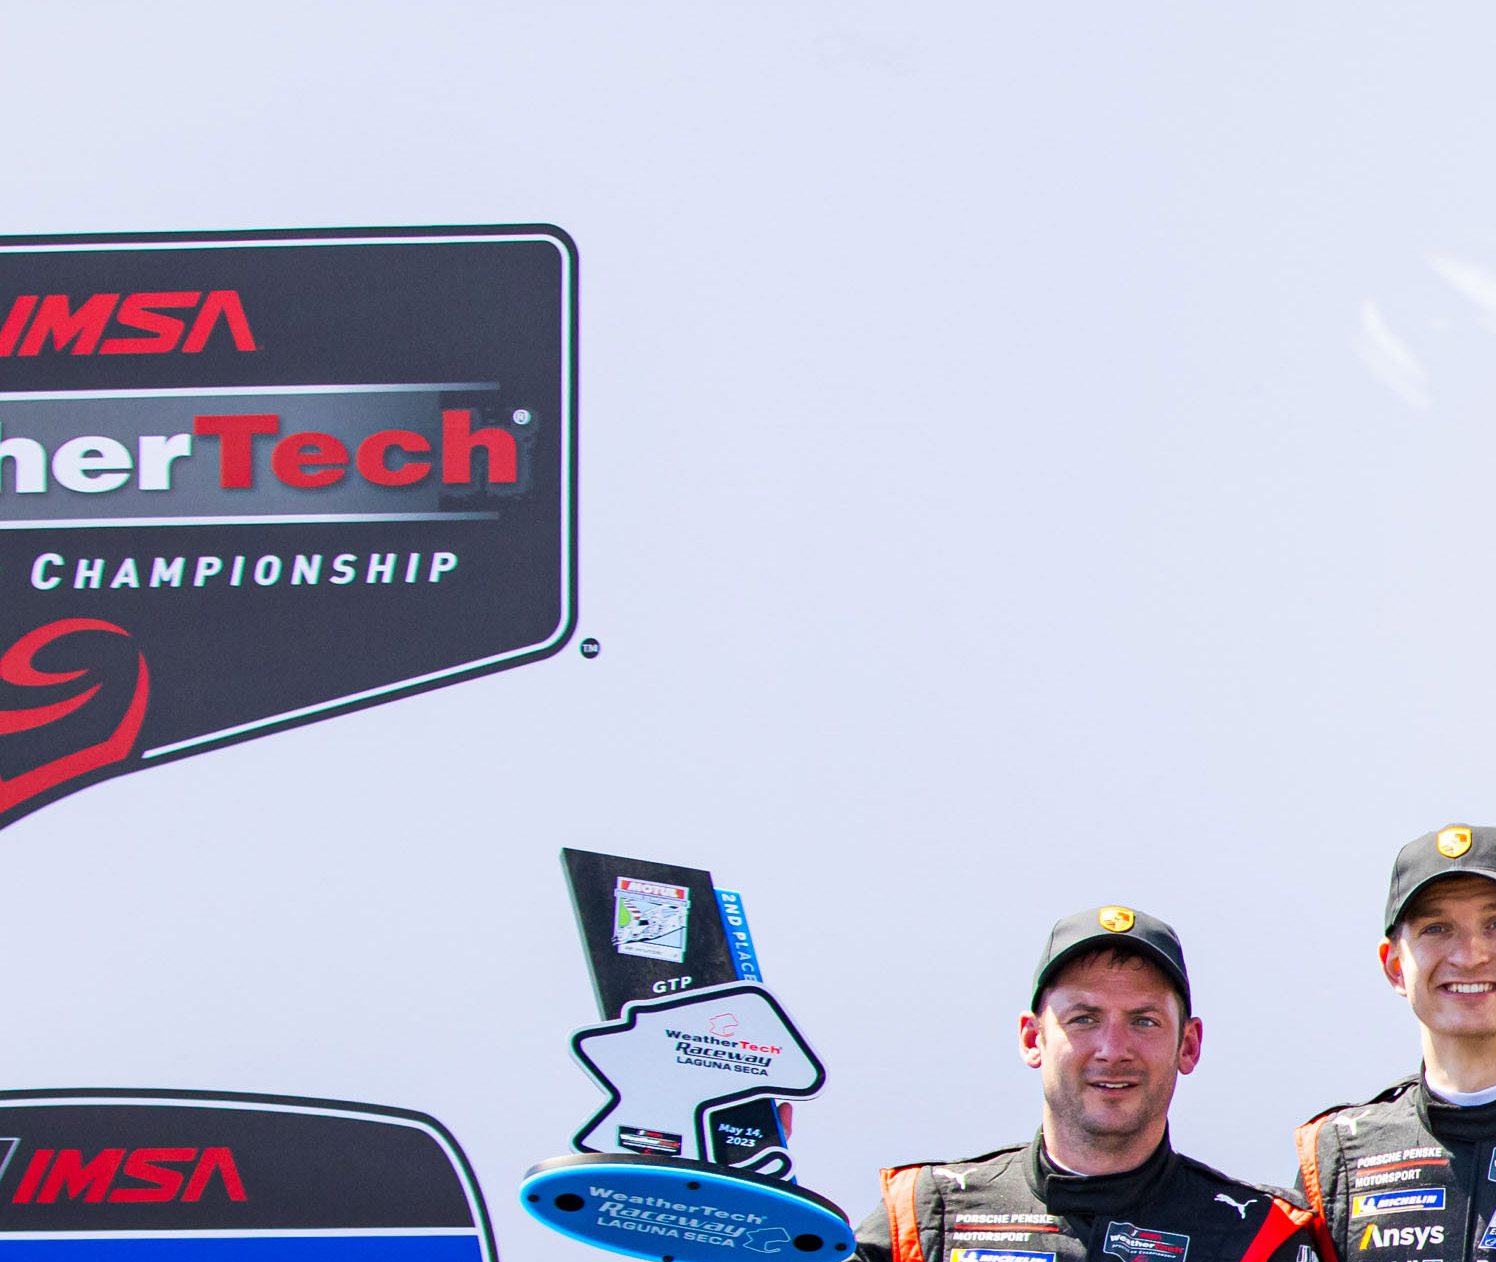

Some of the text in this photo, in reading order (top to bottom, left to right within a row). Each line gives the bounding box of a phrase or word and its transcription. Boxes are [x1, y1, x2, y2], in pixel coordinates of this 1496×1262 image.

[721, 893, 742, 926] 2ND
[652, 975, 692, 993] GTP
[665, 1029, 781, 1054] WeatherTech
[675, 1041, 772, 1067] Raceway
[676, 1055, 768, 1077] LAGUNA SECA
[718, 1123, 741, 1138] May
[725, 1135, 756, 1148] 2023
[1357, 1147, 1442, 1169] PORSCHE PENSKE
[13, 1147, 247, 1204] IMSA
[1355, 1168, 1422, 1188] MOTORSPORT
[589, 1186, 766, 1225] WeatherTech
[1376, 1194, 1438, 1209] MICHELIN
[597, 1200, 747, 1238] Raceway
[955, 1214, 1054, 1224] PORSCHE PENSKE
[597, 1216, 735, 1249] LAGUNA SECA
[953, 1232, 1032, 1242] MOTORSPORT
[1359, 1223, 1445, 1251] Ansys
